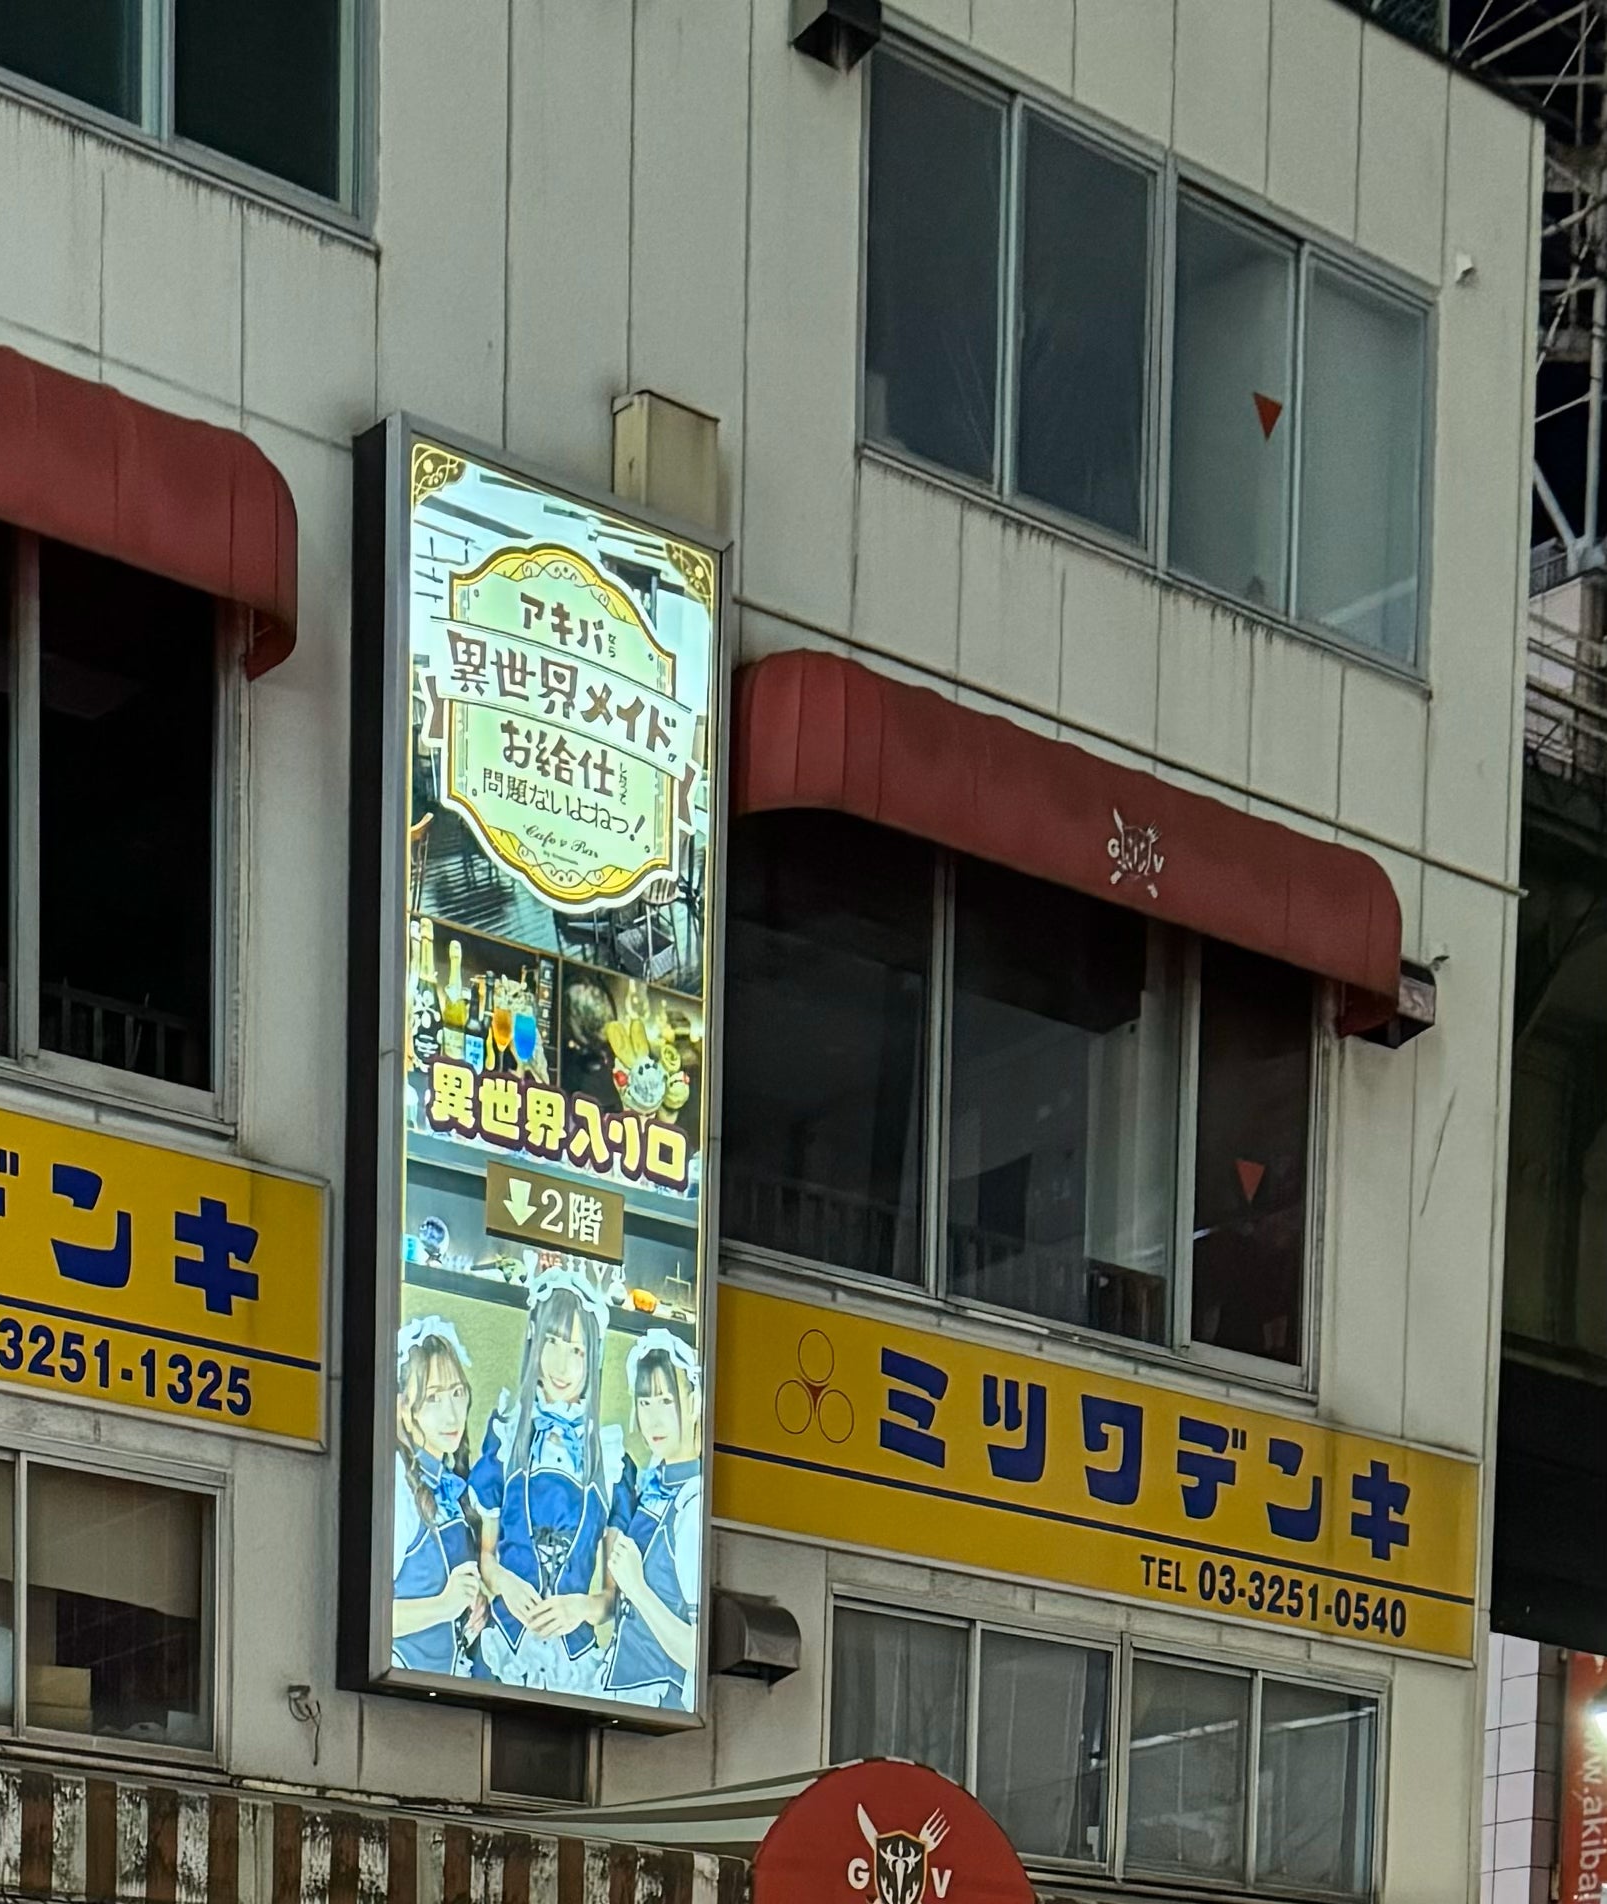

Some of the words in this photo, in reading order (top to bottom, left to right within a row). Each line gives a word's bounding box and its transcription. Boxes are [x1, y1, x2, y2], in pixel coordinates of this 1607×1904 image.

[430, 1062, 687, 1182] 異世界入り口
[540, 1188, 604, 1245] 2階
[879, 1347, 1410, 1561] ミツワデンキ
[1140, 1554, 1188, 1594] TEL
[1198, 1560, 1408, 1639] 03-3251-0540
[847, 1857, 870, 1890] G
[931, 1867, 952, 1899] V
